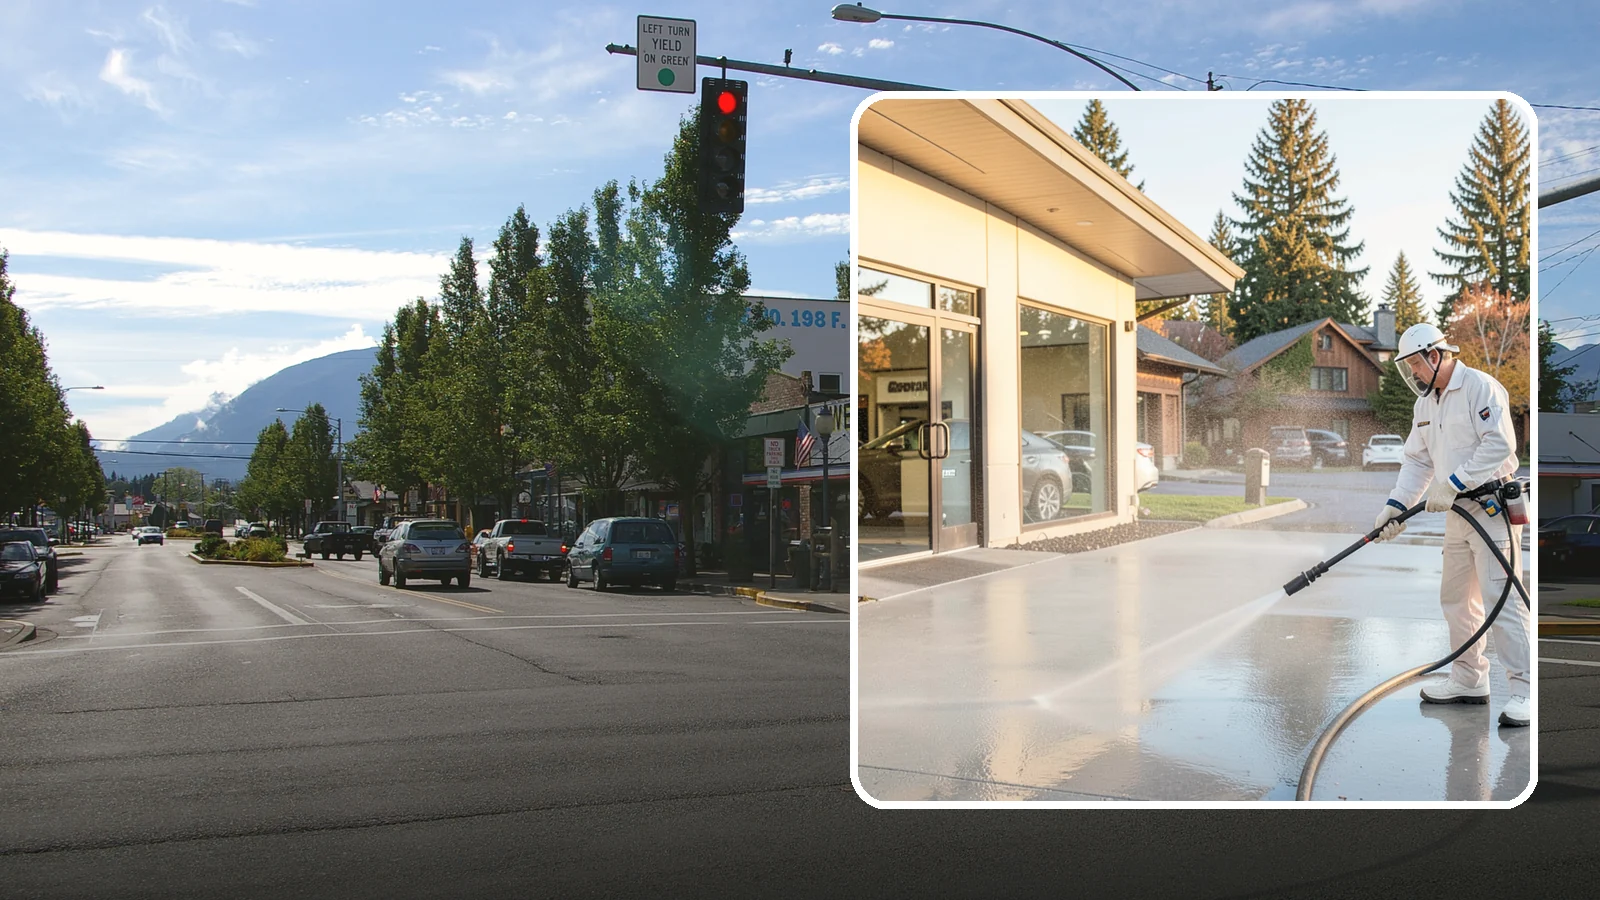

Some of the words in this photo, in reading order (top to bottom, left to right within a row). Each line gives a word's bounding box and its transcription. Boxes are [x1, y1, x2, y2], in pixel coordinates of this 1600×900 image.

[643, 23, 663, 34] LEFT
[668, 25, 690, 36] TURN
[652, 37, 682, 52] YIELD
[644, 53, 656, 63] ON
[791, 309, 826, 328] 198
[831, 311, 847, 329] F.
